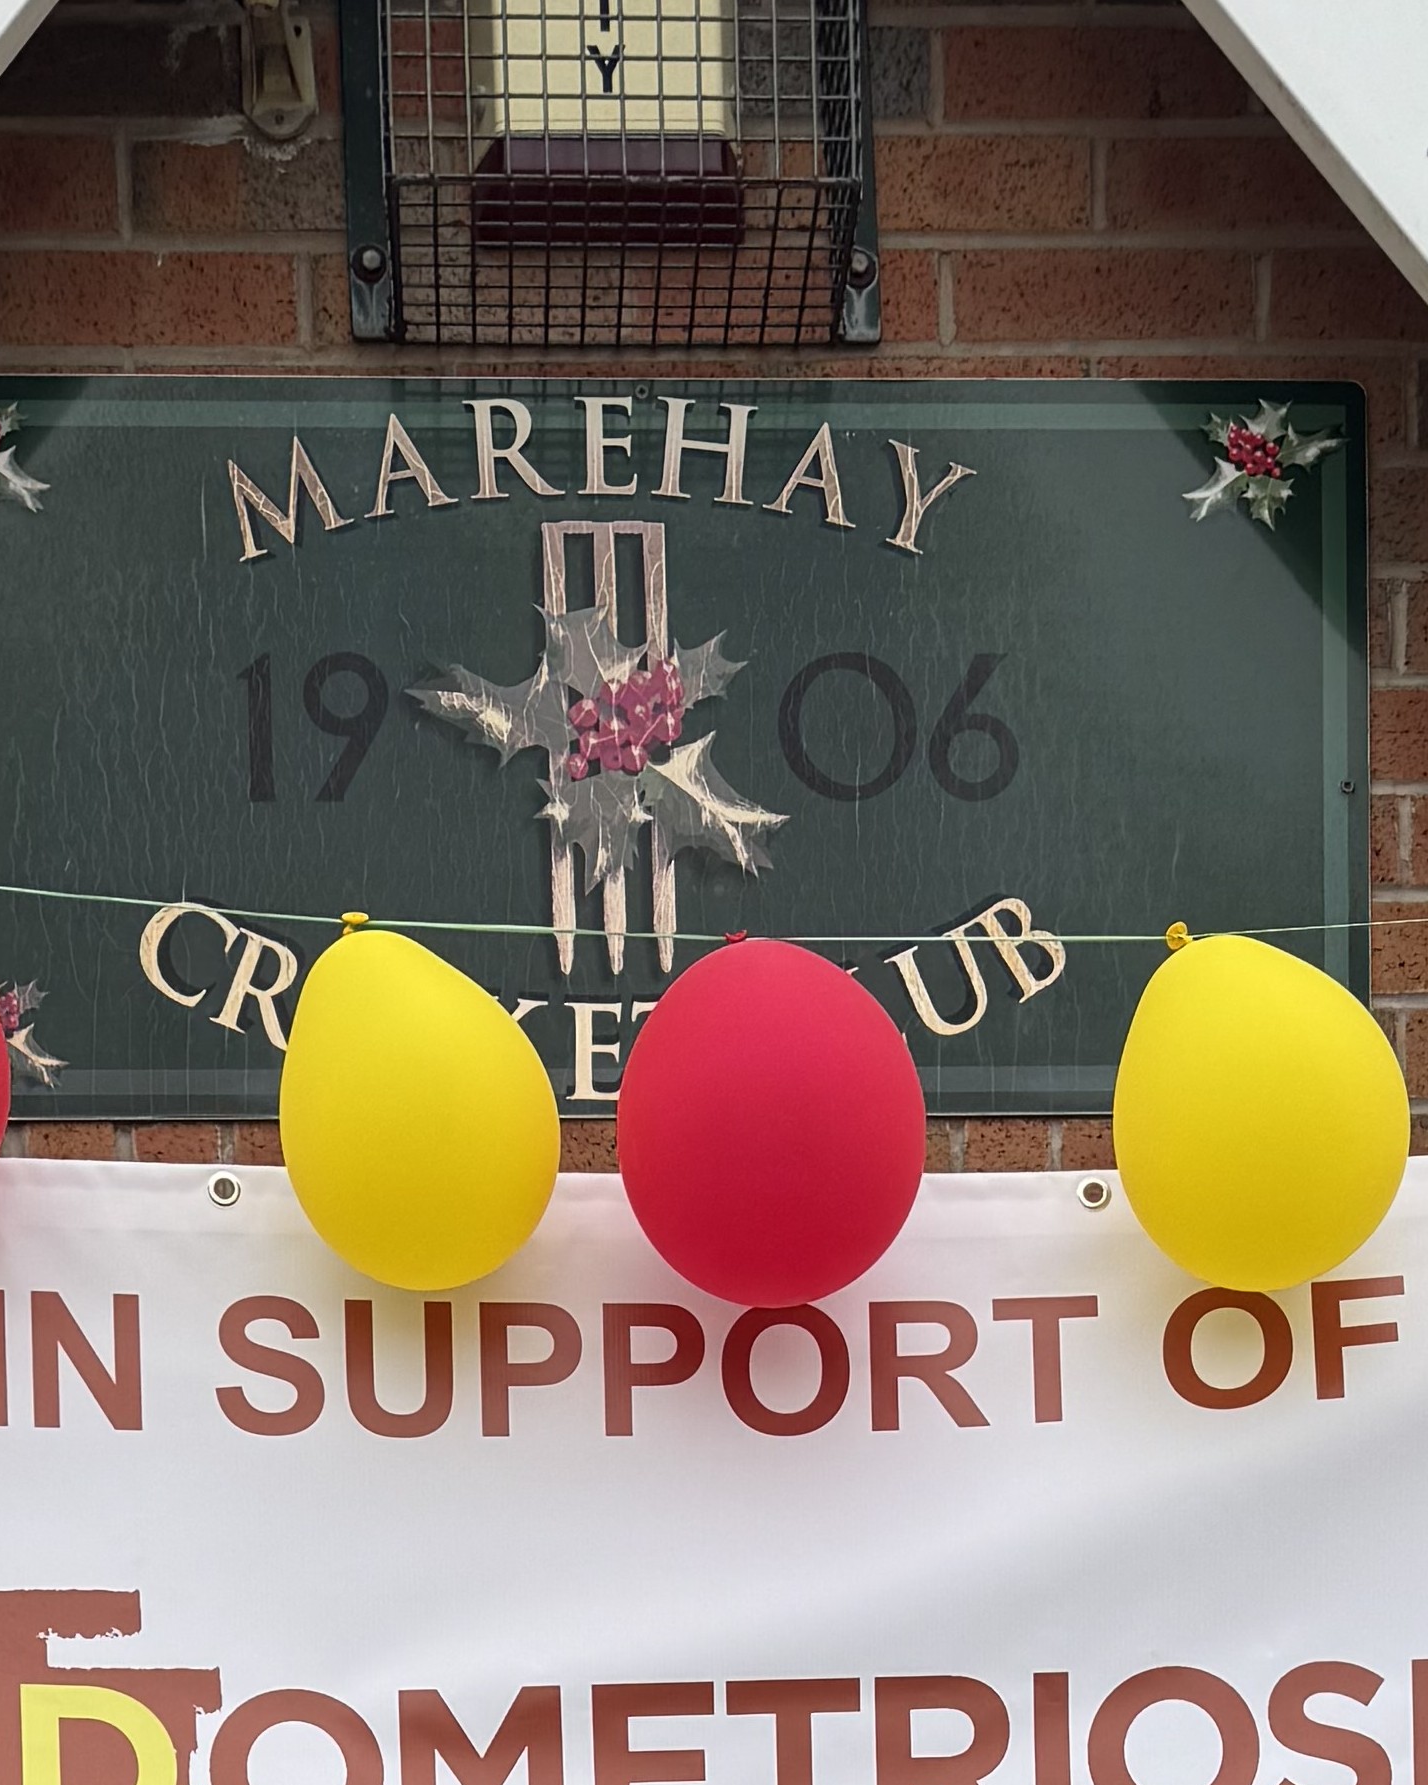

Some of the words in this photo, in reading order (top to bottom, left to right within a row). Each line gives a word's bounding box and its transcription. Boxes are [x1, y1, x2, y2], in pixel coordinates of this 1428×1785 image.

[227, 395, 977, 563] MAREHAY
[236, 651, 388, 804] 19
[777, 651, 1021, 802] 06
[846, 897, 1066, 1044] UB
[215, 1294, 1099, 1438] SUPPORT
[1162, 1275, 1406, 1410] OF
